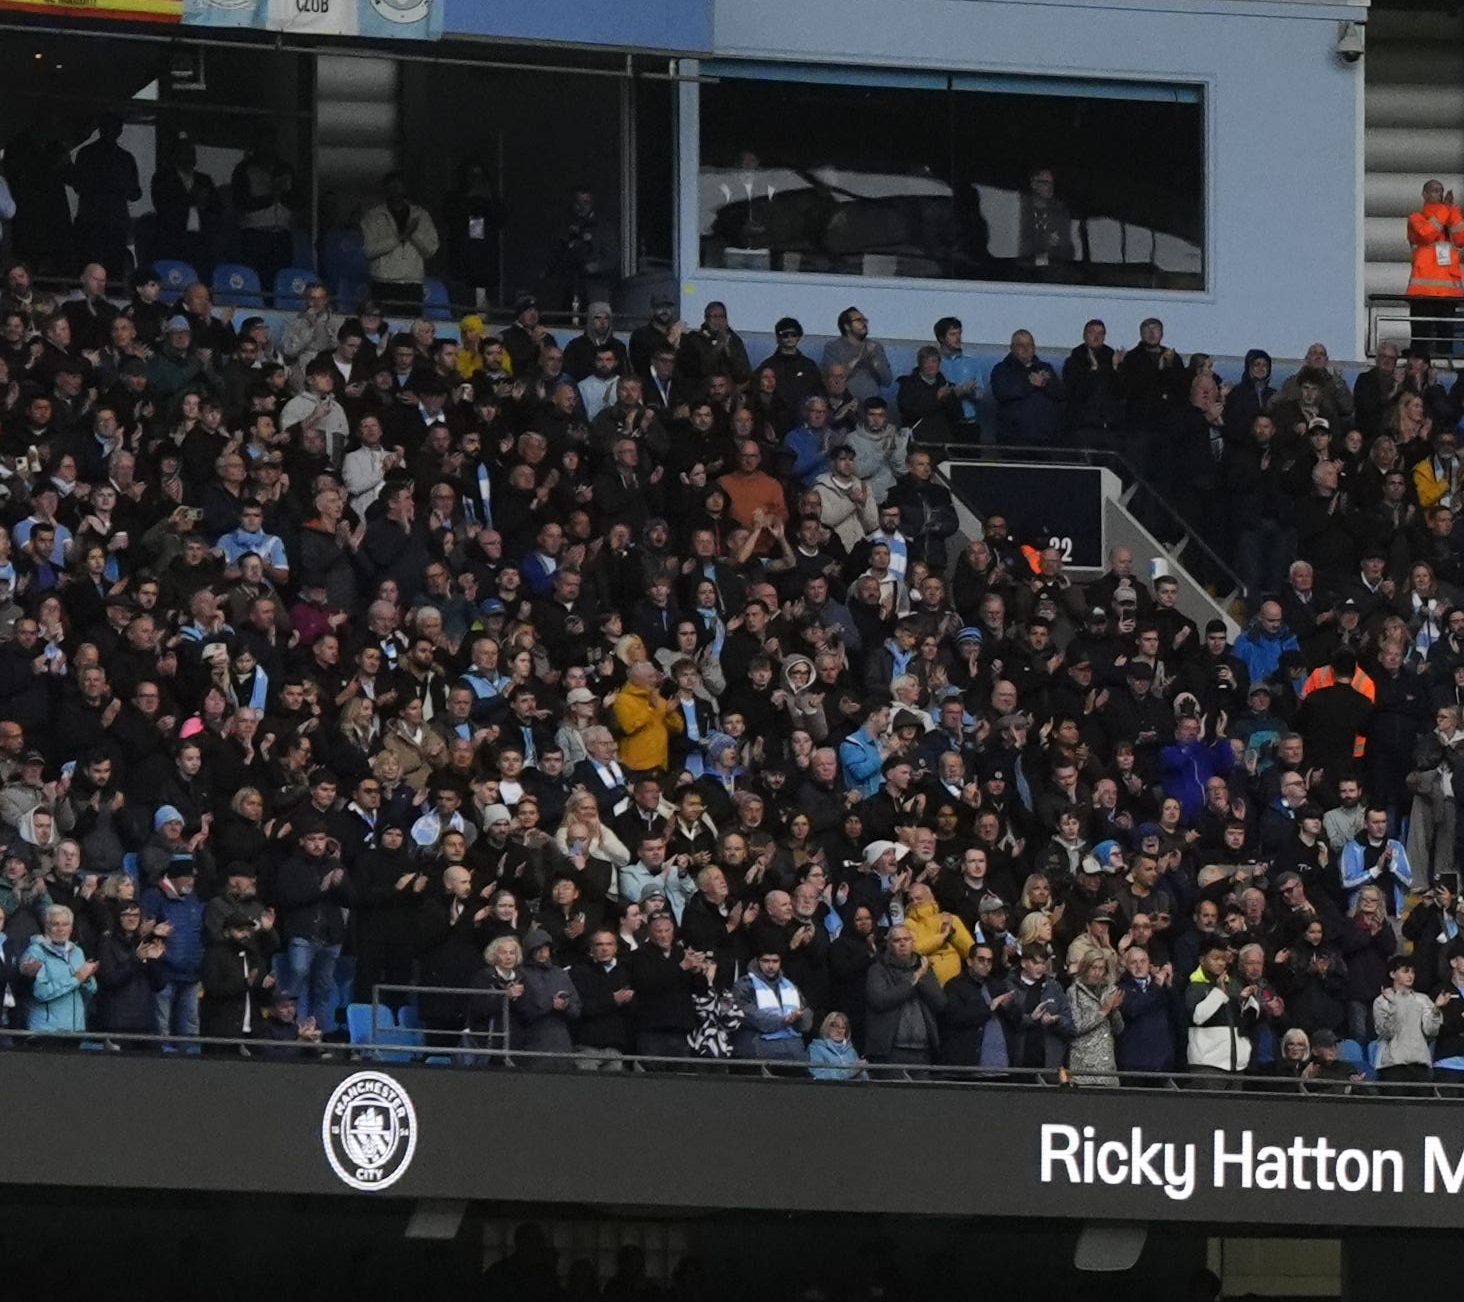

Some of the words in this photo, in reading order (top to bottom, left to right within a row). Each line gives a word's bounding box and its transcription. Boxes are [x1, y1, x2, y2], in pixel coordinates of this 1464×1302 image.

[334, 1080, 407, 1117] MANCHESTER
[355, 1168, 384, 1181] CITY
[1040, 1123, 1196, 1200] Ricky
[1213, 1129, 1404, 1193] Hatton
